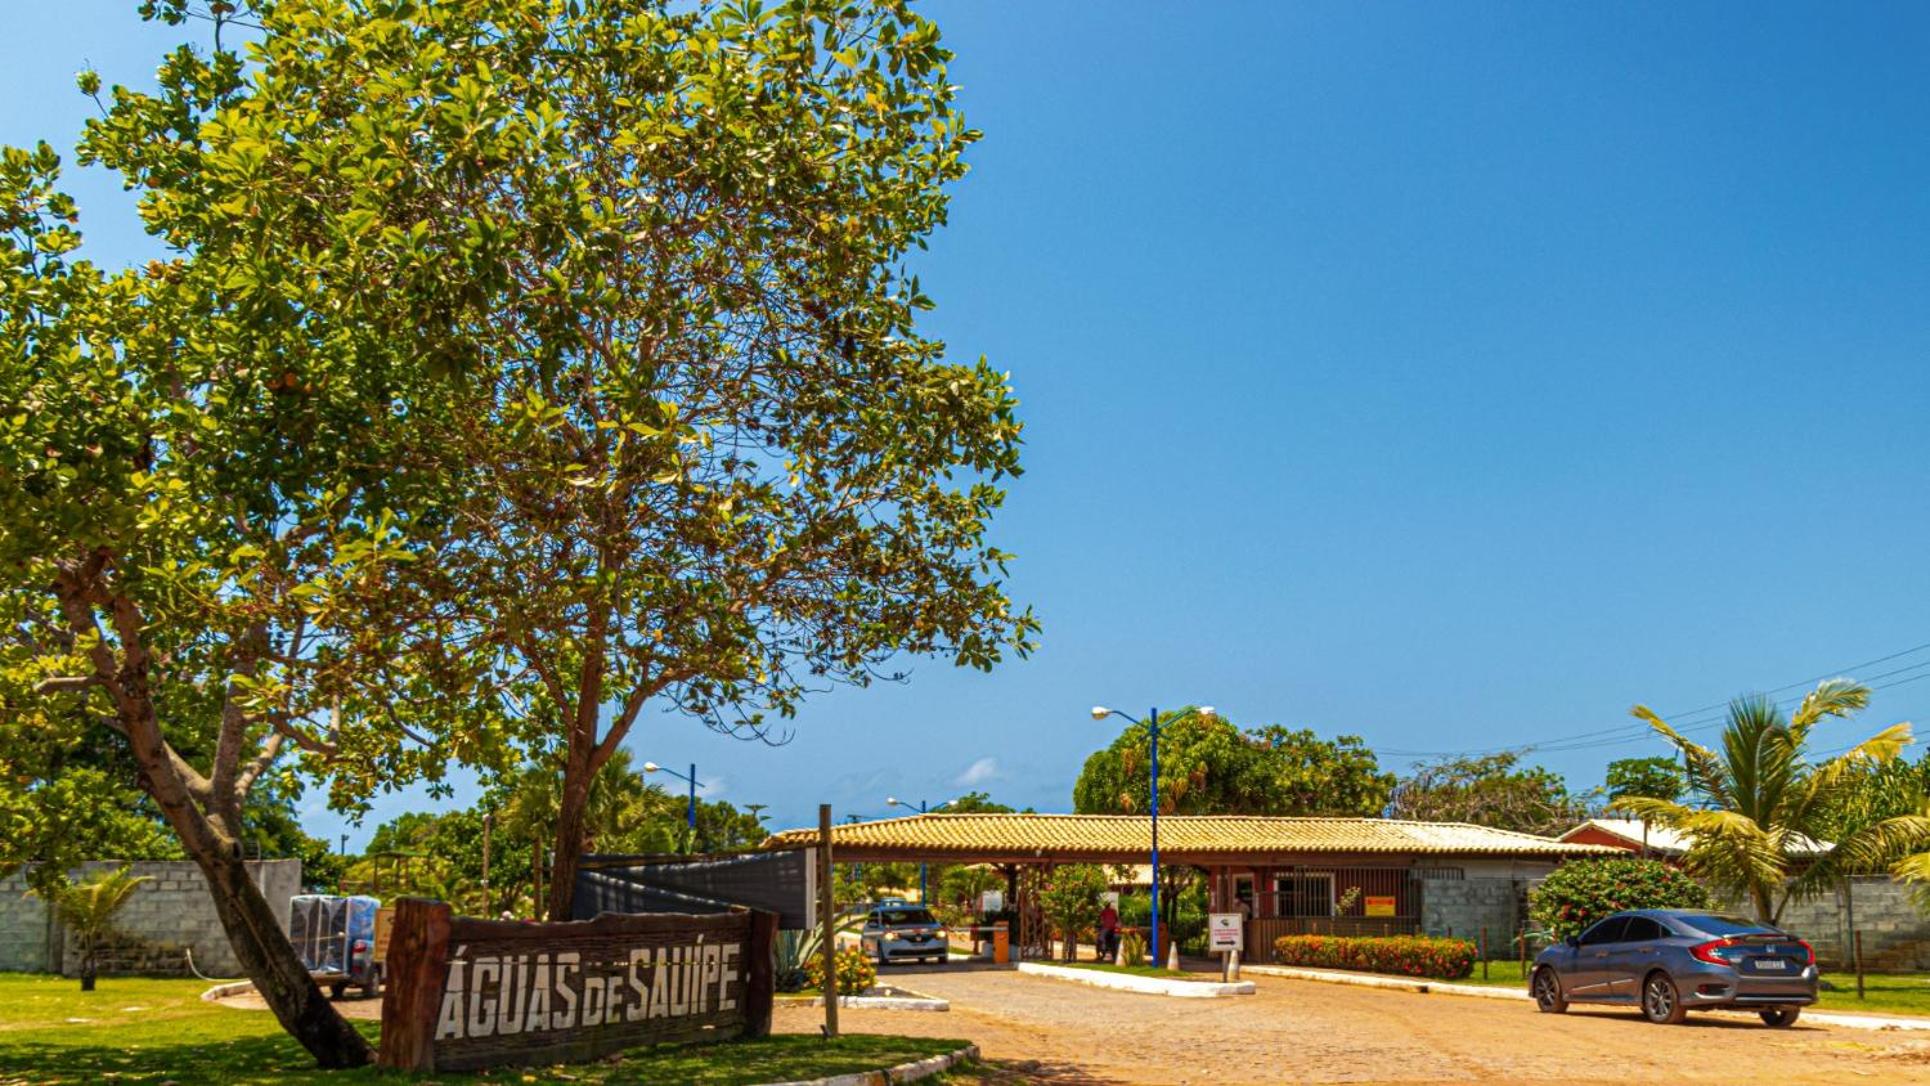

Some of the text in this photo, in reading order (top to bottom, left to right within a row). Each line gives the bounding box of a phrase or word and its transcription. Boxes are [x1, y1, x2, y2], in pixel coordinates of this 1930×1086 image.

[434, 933, 741, 1041] ÁGUAS DE SAUÍPE
